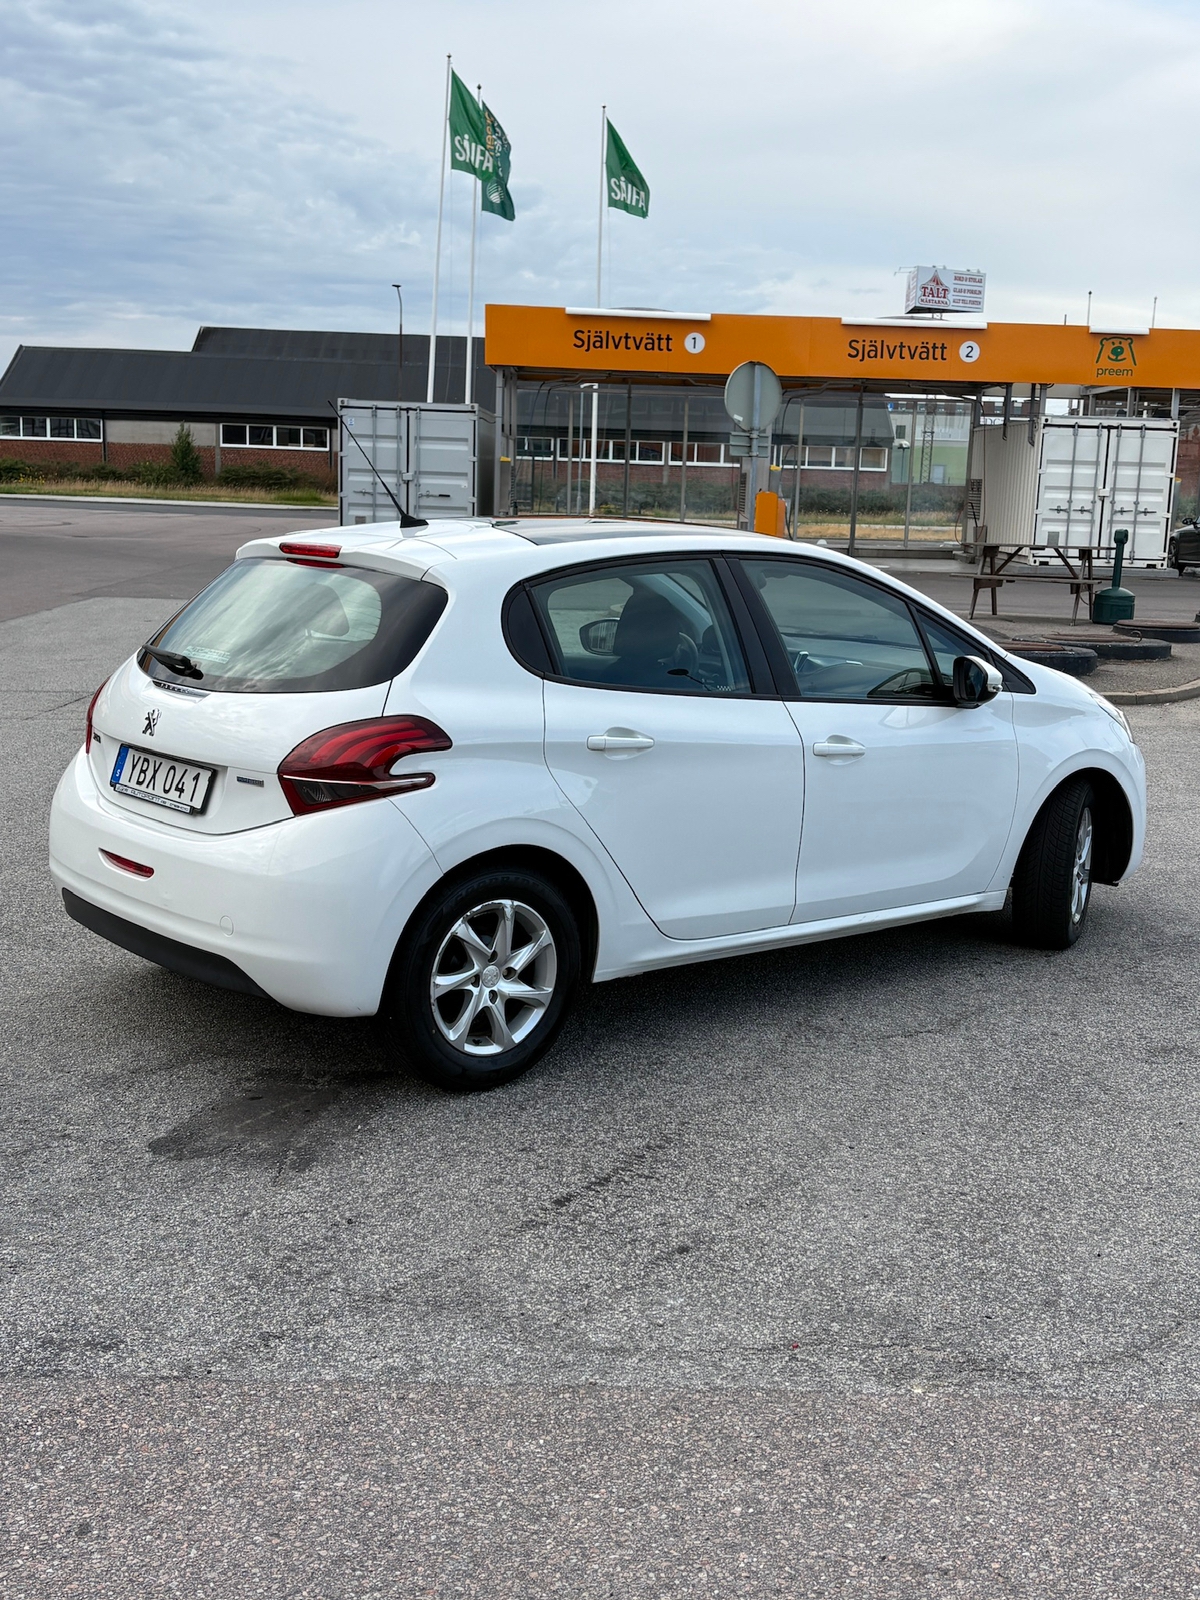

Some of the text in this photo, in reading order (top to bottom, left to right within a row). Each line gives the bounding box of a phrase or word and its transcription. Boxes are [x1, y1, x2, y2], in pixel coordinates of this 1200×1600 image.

[573, 329, 697, 352] Självtvätt 1
[847, 339, 974, 362] Självtvätt 2
[1096, 367, 1133, 378] preem
[128, 754, 201, 803] YBX 041
